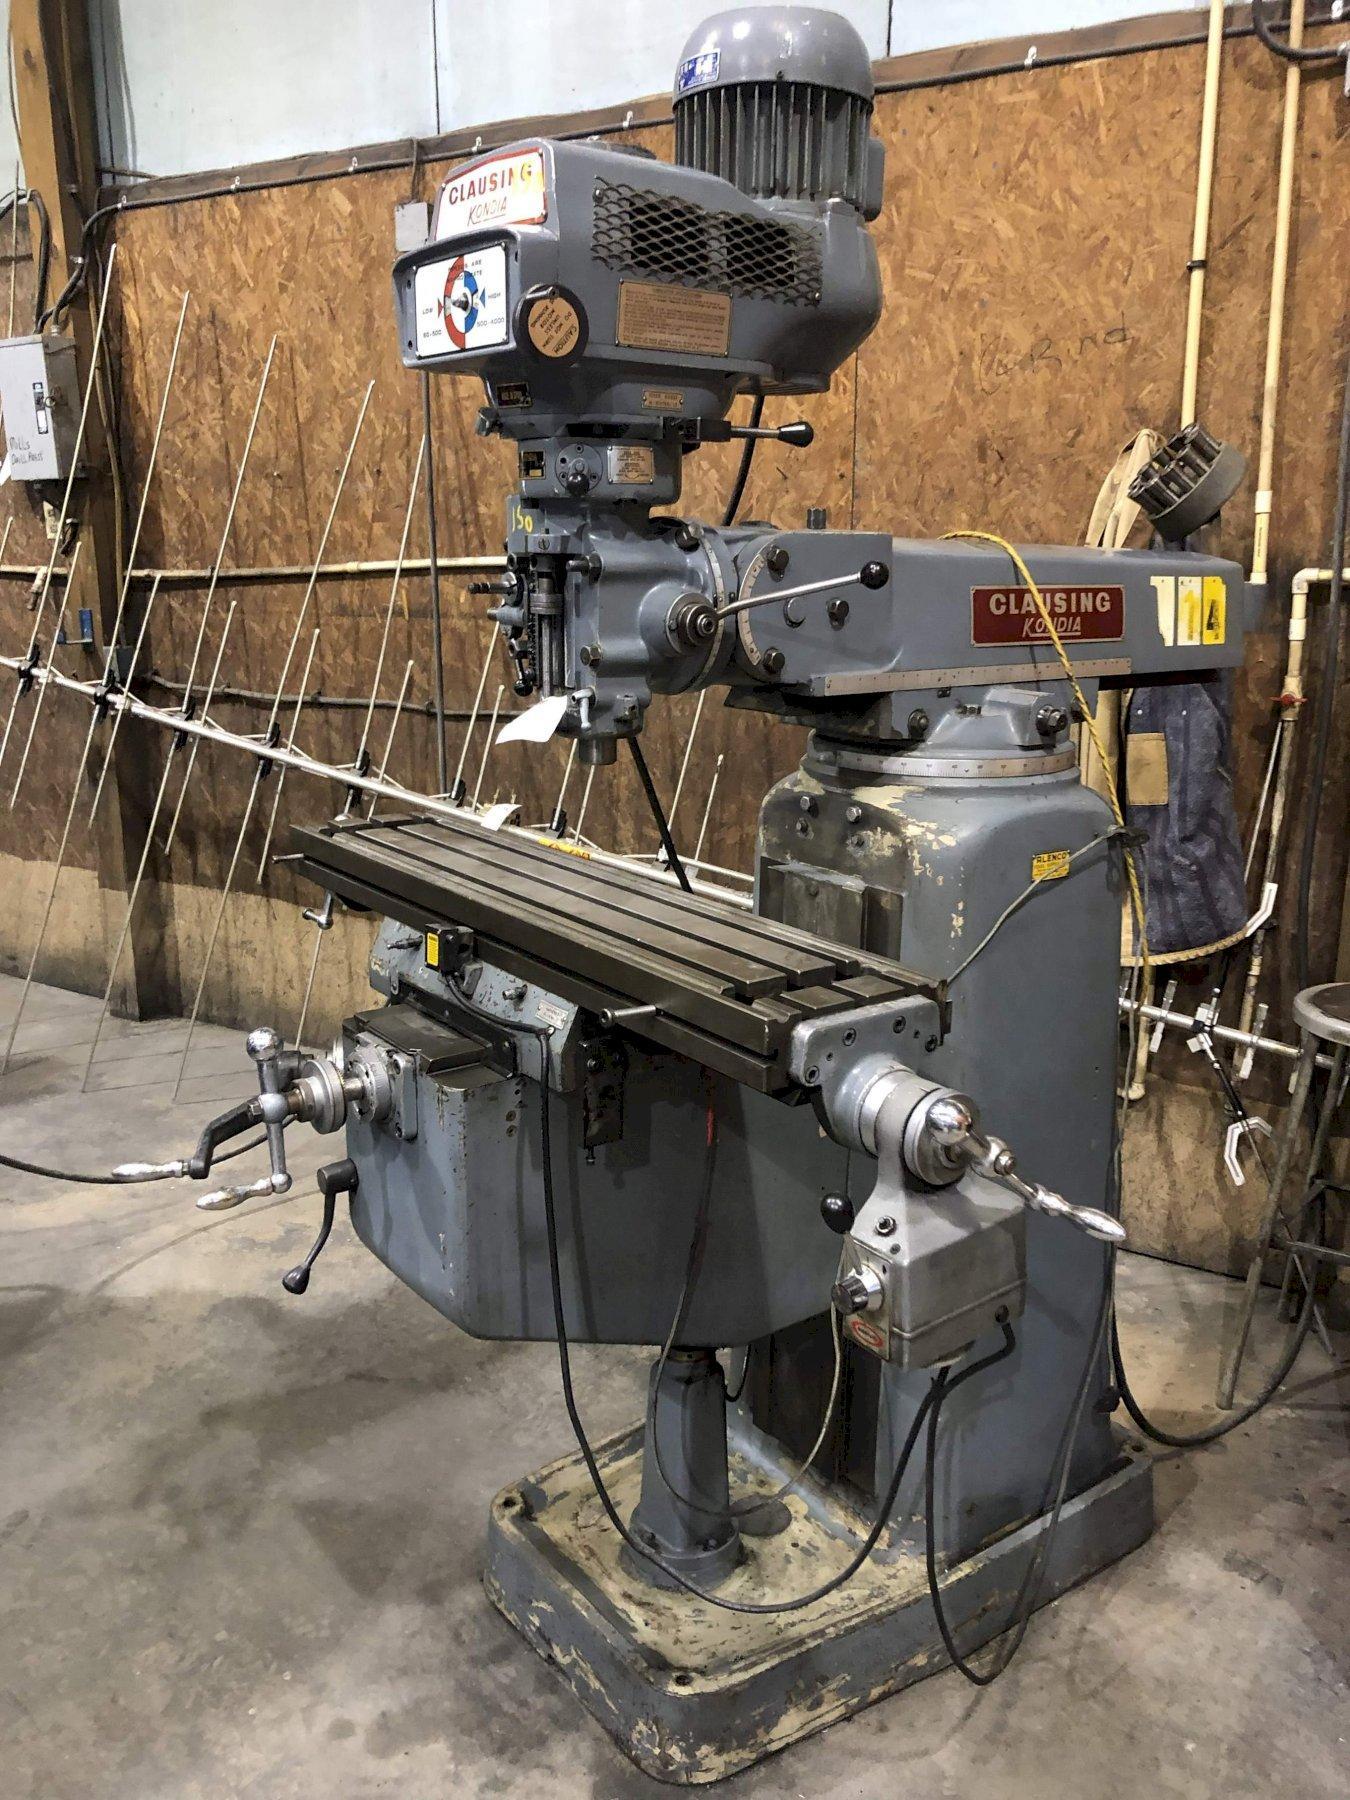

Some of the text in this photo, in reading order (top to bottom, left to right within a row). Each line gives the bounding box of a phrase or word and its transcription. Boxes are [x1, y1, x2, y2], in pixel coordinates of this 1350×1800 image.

[553, 324, 577, 354] CAUTION
[512, 504, 533, 533] 150
[989, 592, 1111, 616] CLAUSING
